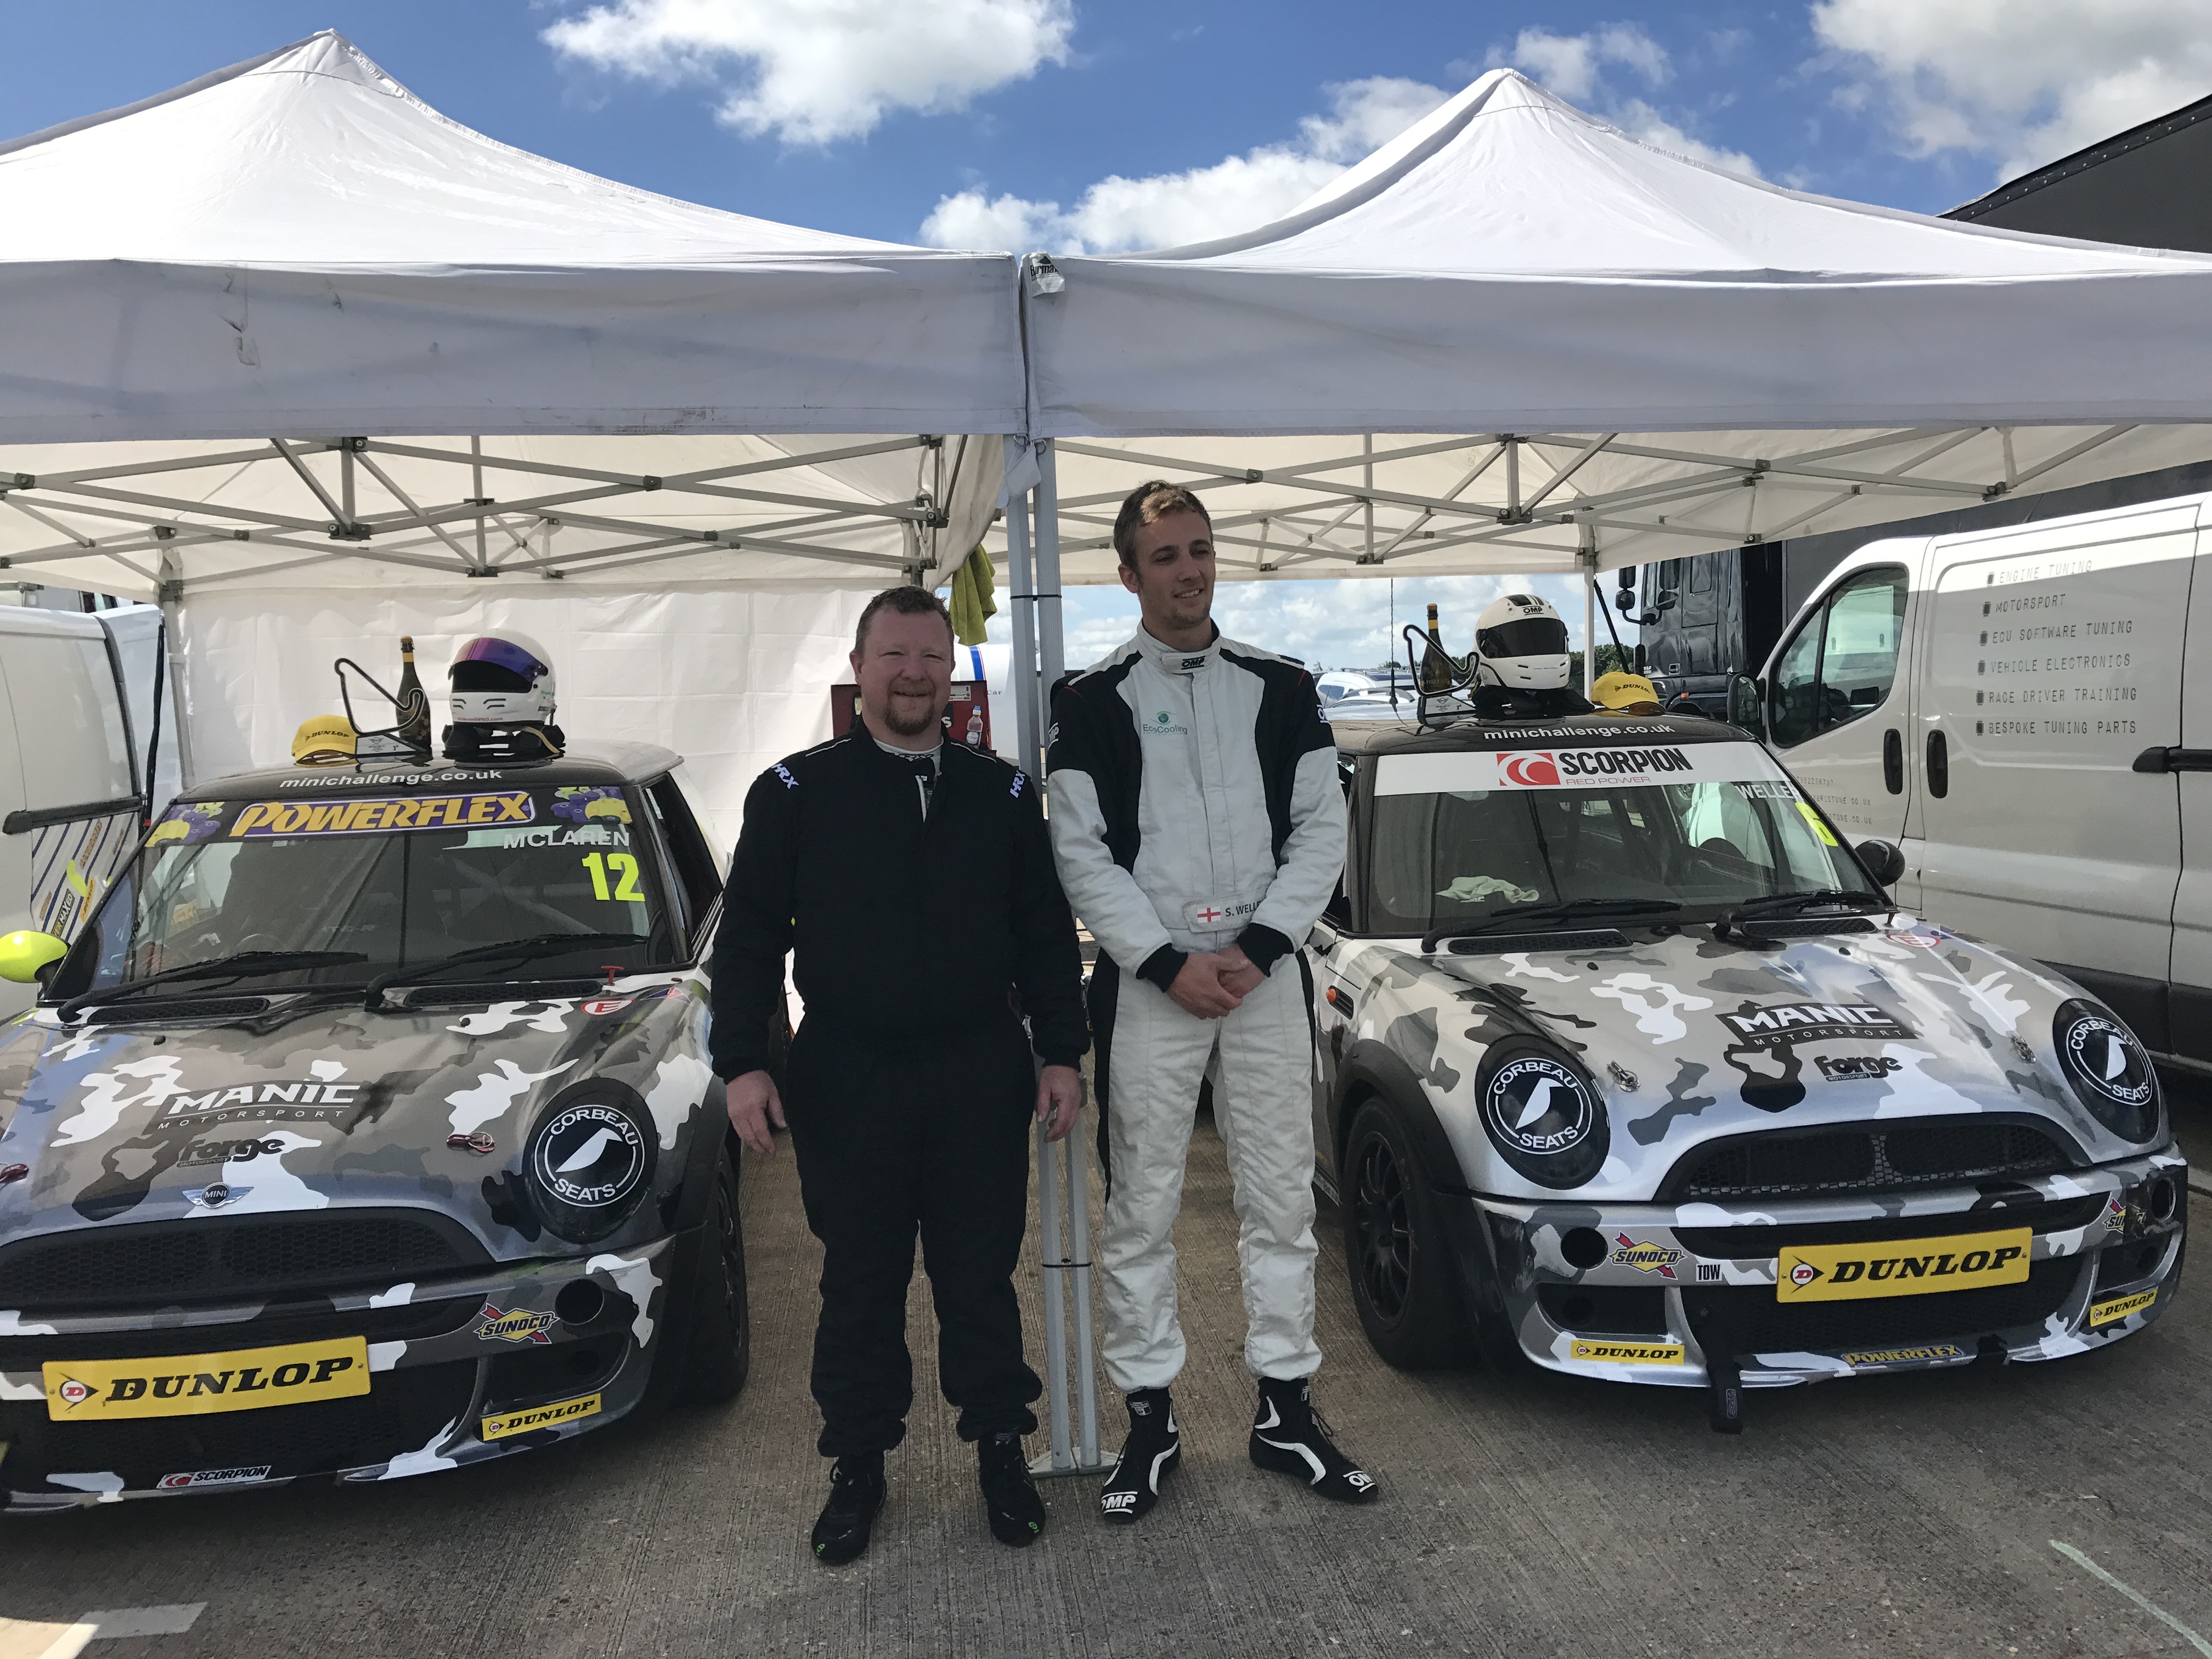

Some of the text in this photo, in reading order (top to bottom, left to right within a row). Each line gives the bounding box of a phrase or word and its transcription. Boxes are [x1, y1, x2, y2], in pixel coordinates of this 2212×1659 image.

[2000, 560, 2092, 583] ENGINE TUNING
[1996, 594, 2066, 613] MOTORSPORT
[1993, 620, 2132, 644] ECU SOFTWARE TUNING
[1181, 657, 1205, 667] OMP
[1991, 653, 2130, 674] VEHICLE ELECTRONICS
[1622, 684, 1650, 693] DUNLO
[1989, 687, 2137, 703] RACE DRIVER TRAINING
[1483, 724, 1675, 740] minichallenge.co.uk
[1989, 720, 2136, 734] BESPOKE TUNING PARTS
[1558, 748, 1694, 775] SCORPION
[279, 770, 502, 788] minichallenge.co.uk
[771, 764, 799, 789] HRX
[1009, 770, 1025, 798] HRX
[229, 793, 531, 837] POWERFLEX
[503, 830, 630, 850] MCLAREN
[582, 853, 645, 901] 12
[58, 894, 73, 922] MAXED
[1225, 907, 1234, 917] S.
[1726, 1006, 1894, 1032] MANIC
[1754, 1028, 1905, 1046] MOTORSPORT
[2071, 1020, 2133, 1050] CORBEAU
[1496, 1062, 1578, 1094] CORBEAU
[168, 1084, 360, 1114] MANIC
[2112, 1082, 2149, 1101] SEATS
[158, 1110, 343, 1130] MOTORSPORT
[550, 1109, 639, 1145] CORBEAU
[1520, 1126, 1578, 1149] SEATS
[204, 1189, 227, 1198] MINI
[555, 1178, 616, 1201] SEATS
[1614, 1250, 1679, 1263] SUNOCO
[1828, 1246, 2022, 1284] DUNLOP
[1697, 1264, 1721, 1280] TOW
[2103, 1292, 2155, 1317] DUNLOP
[483, 1314, 551, 1336] SUNOCO
[1591, 1346, 1679, 1359] DUNLOP
[1844, 1345, 1960, 1365] POWERFLEX
[105, 1357, 354, 1401] DUNLOP
[506, 1400, 596, 1429] DUNLOP
[194, 1466, 268, 1481] SCORPION
